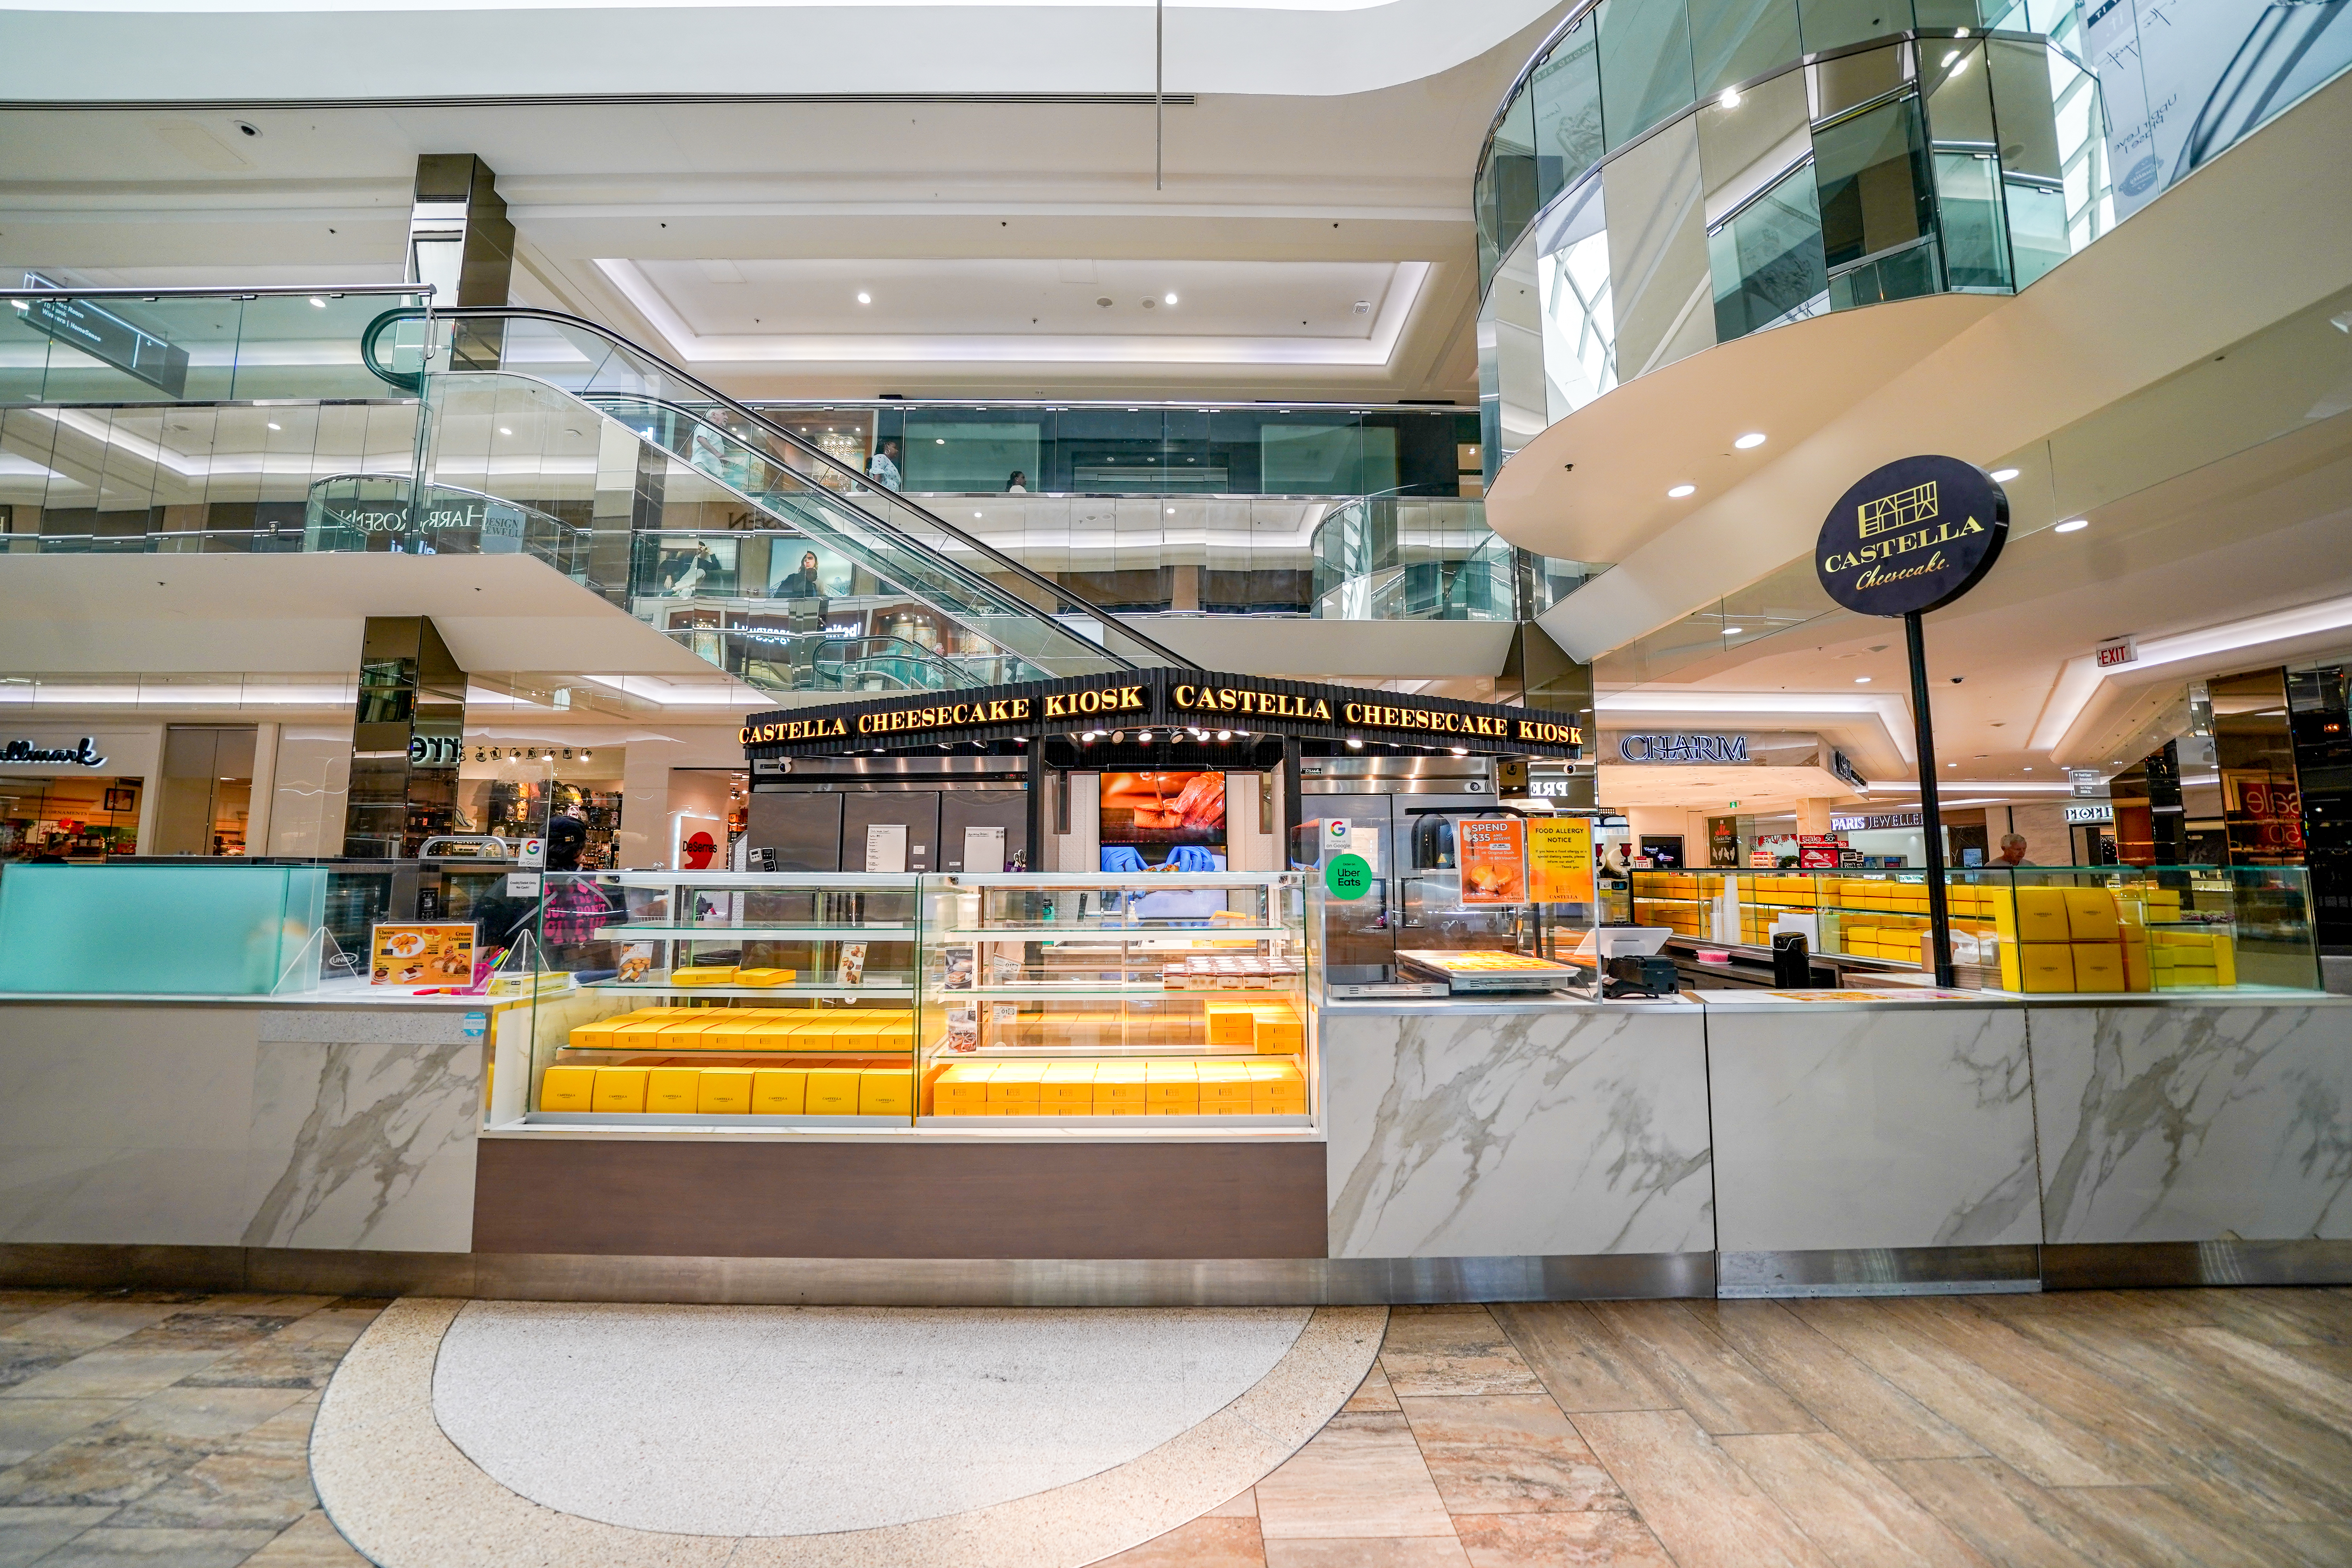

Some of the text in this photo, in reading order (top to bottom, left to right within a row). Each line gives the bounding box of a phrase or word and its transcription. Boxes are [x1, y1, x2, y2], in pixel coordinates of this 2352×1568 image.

[42, 308, 101, 342] Winers HomeSense
[1824, 516, 1984, 573] CASTELLA
[2101, 646, 2125, 665] EXIT
[738, 686, 1143, 744] CASTELLA CHEESECAKE KIOSK
[1175, 685, 1584, 745] CASTELLA CHEESECAKE KIOSK
[1622, 734, 1751, 761] CHARM
[1471, 823, 1508, 832] SPEND
[1832, 817, 1865, 831] PARIS
[682, 840, 717, 853] DeSerres
[1472, 833, 1491, 843] $35
